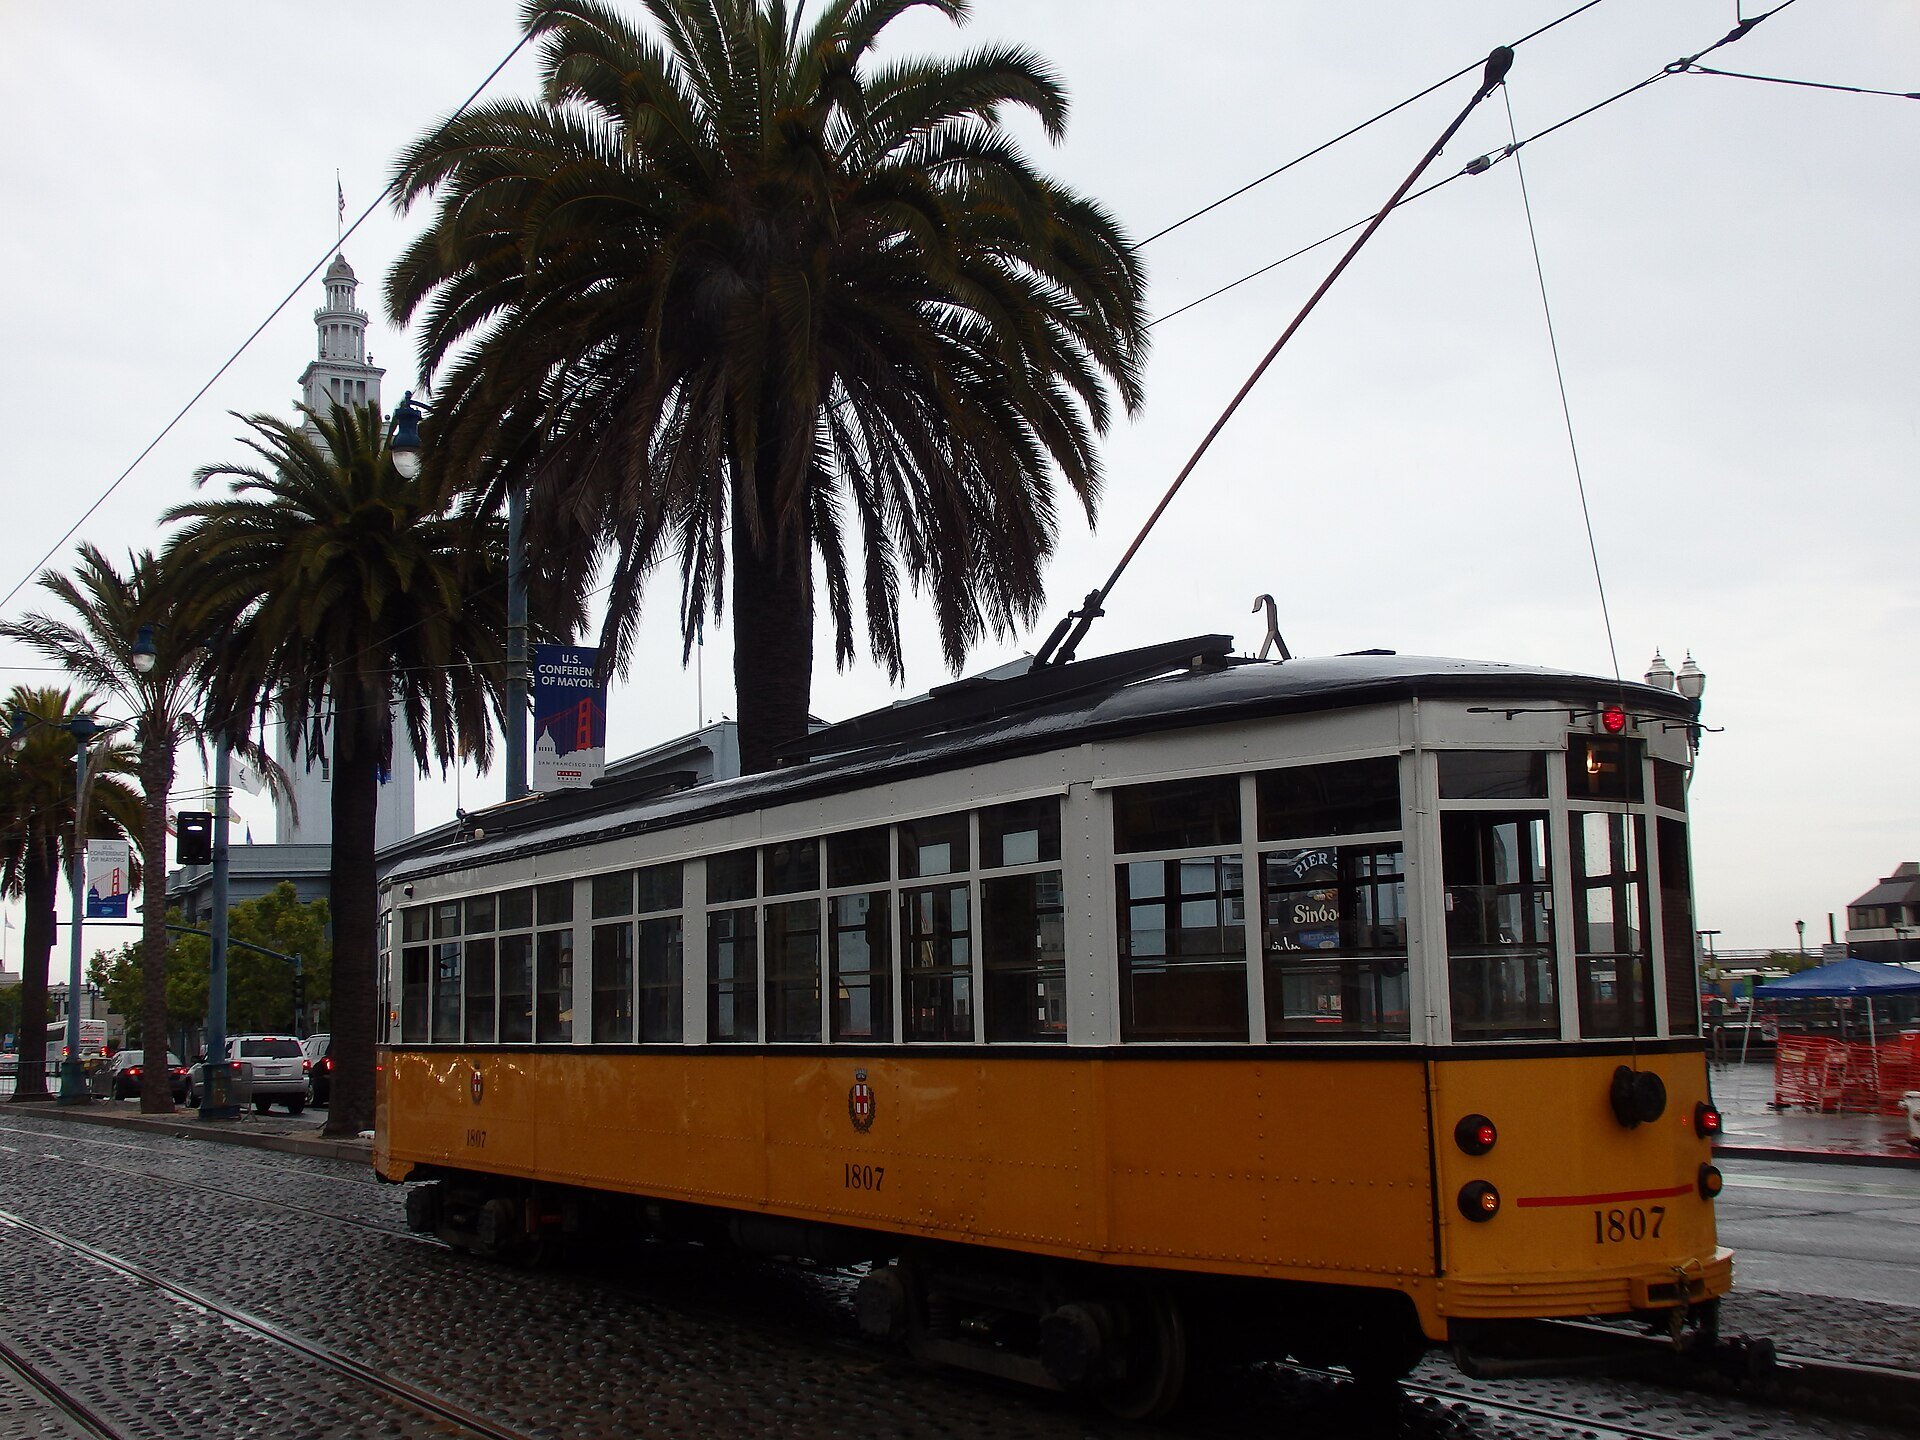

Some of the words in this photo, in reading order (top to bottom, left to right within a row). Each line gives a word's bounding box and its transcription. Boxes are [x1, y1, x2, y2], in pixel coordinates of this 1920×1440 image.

[561, 654, 582, 664] U.S.
[538, 664, 602, 677] CONFEREN
[541, 676, 556, 686] OF
[1293, 852, 1329, 879] PIER
[1292, 903, 1340, 924] Sinba
[466, 1129, 487, 1149] 1807
[844, 1162, 885, 1192] 1807
[1593, 1205, 1667, 1245] 1807
